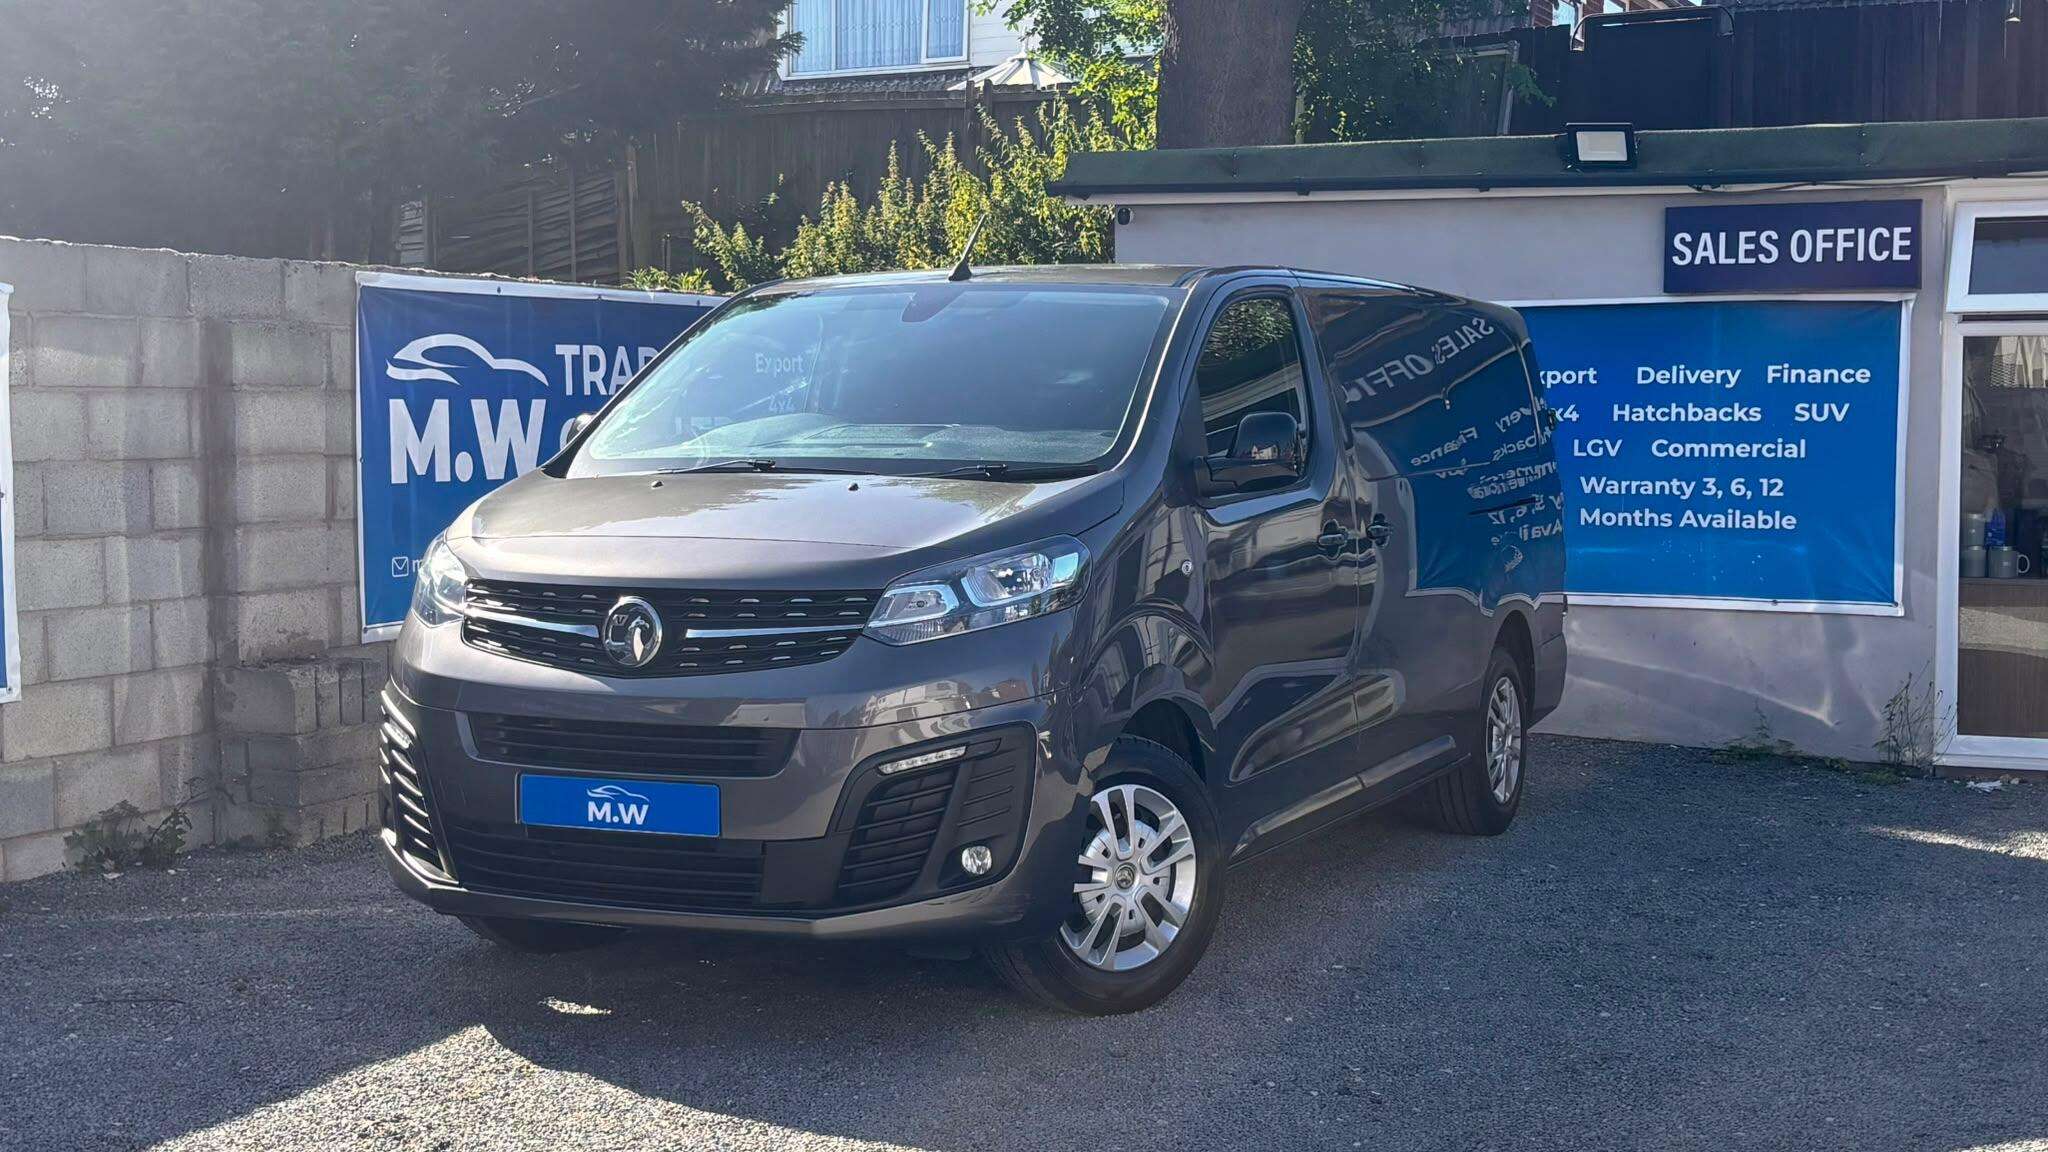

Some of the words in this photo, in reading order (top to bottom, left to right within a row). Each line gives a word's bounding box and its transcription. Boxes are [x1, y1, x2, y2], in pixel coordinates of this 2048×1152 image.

[1672, 230, 1779, 266] SALES
[1790, 226, 1912, 263] OFFICE
[1637, 364, 1742, 388] Delivery
[1767, 363, 1871, 384] Finance
[1551, 404, 1580, 422] x4
[1613, 402, 1762, 422] Hatchbacks
[1795, 403, 1850, 422] SUV
[389, 398, 546, 485] M.W
[1574, 439, 1622, 457] LGV
[1651, 438, 1806, 458] Commercial
[1580, 476, 1696, 500] Warranty
[1702, 477, 1723, 499] 3,
[1730, 478, 1752, 500] 6,
[1759, 478, 1784, 497] 12
[1580, 508, 1673, 527] Months
[1679, 509, 1797, 530] Available
[587, 801, 649, 825] M.W
